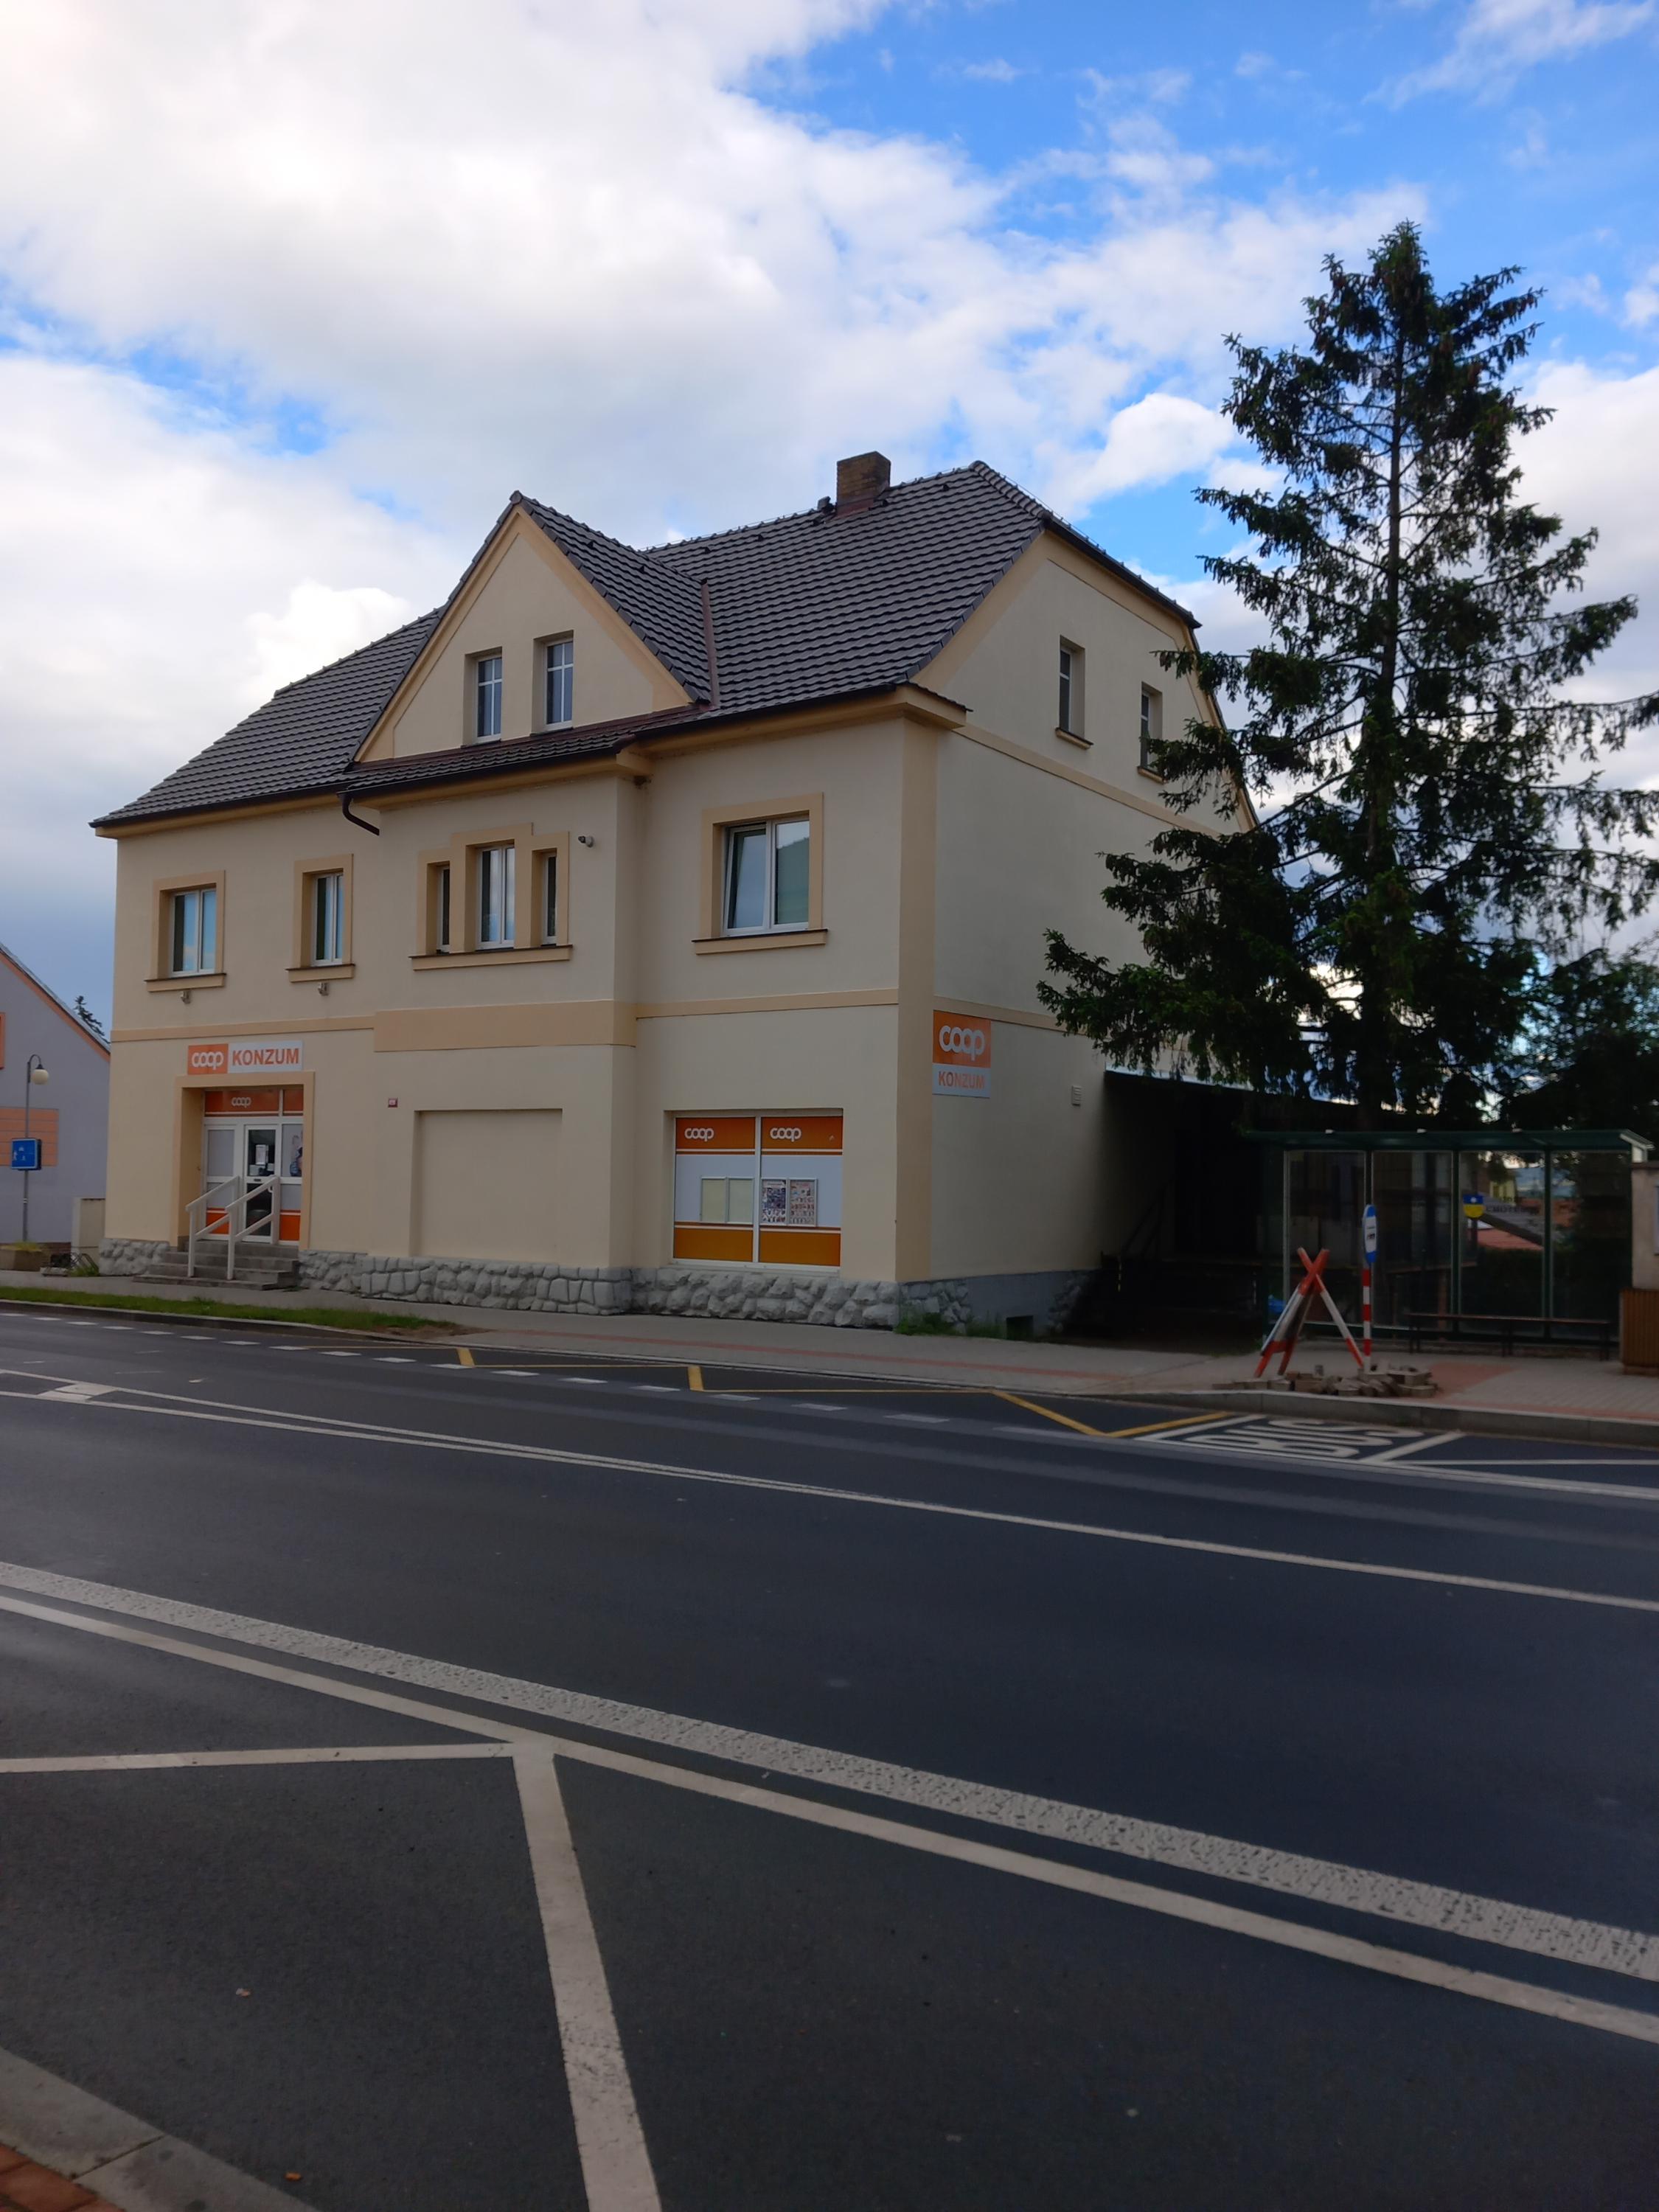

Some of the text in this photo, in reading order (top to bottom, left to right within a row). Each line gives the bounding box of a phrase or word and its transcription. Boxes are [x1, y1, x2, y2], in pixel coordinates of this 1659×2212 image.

[939, 1026, 985, 1062] coop
[192, 1048, 299, 1070] coop KONZUM
[939, 1071, 984, 1089] KONZUM
[232, 1097, 251, 1107] coop
[684, 1127, 714, 1142] coop
[770, 1127, 802, 1142] coop
[1183, 1419, 1425, 1458] BUS
